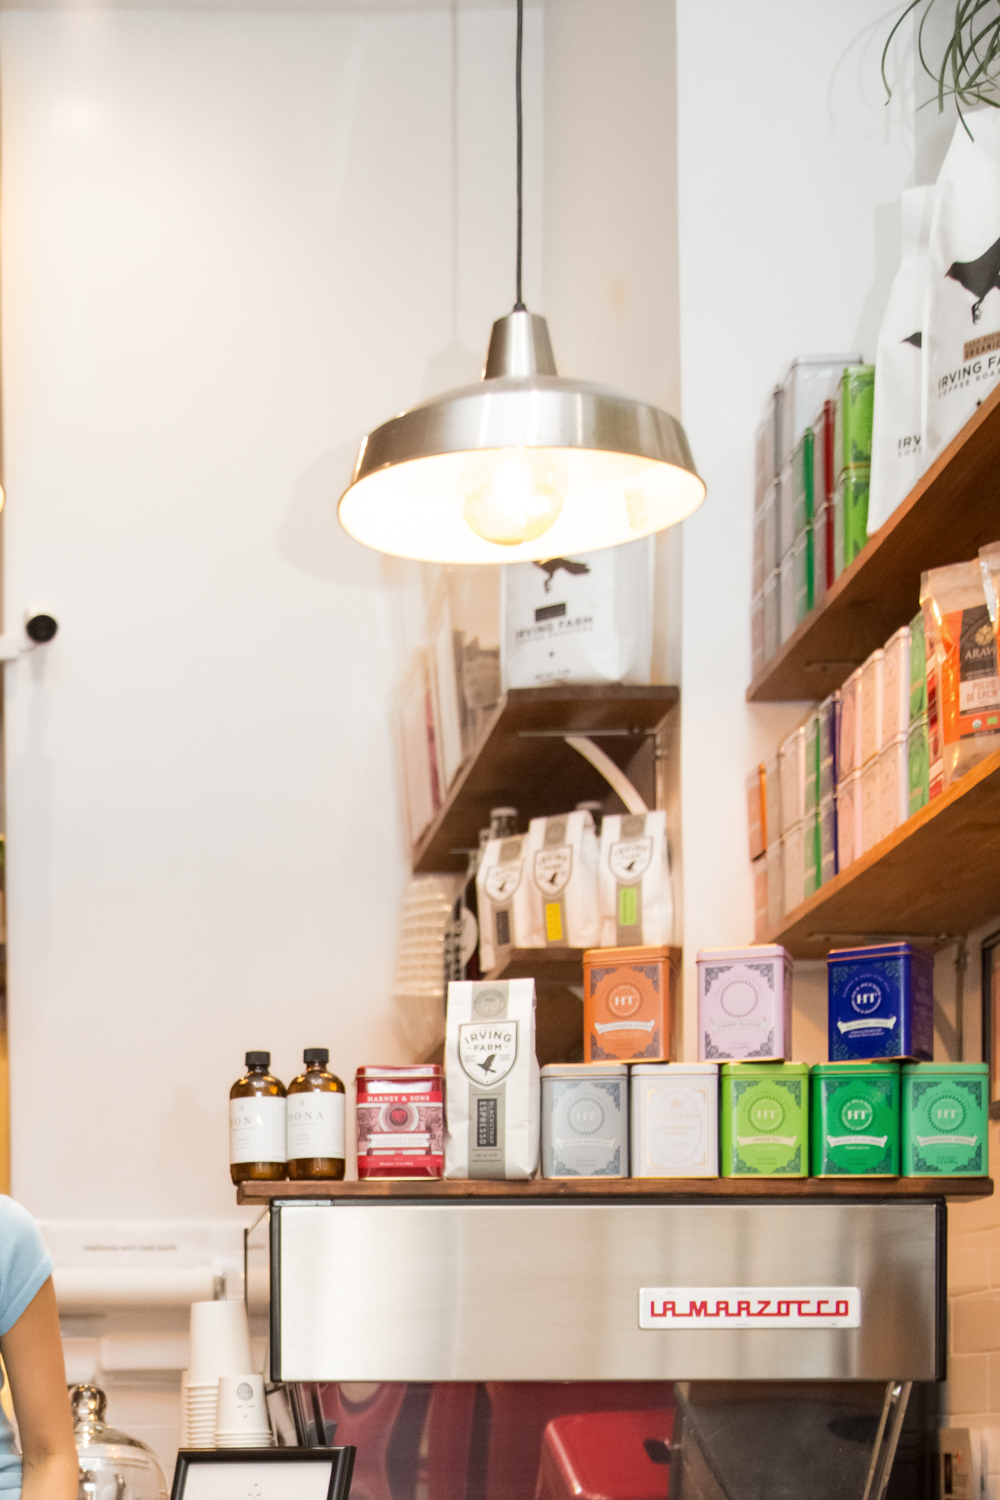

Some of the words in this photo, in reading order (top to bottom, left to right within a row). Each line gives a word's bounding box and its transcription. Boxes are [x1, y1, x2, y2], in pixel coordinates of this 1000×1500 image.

[938, 361, 982, 391] IRVING
[464, 1030, 512, 1044] IRVING
[478, 1101, 487, 1145] ESPRESSO
[650, 1300, 676, 1318] LA
[689, 1300, 849, 1318] MARZOCCO
